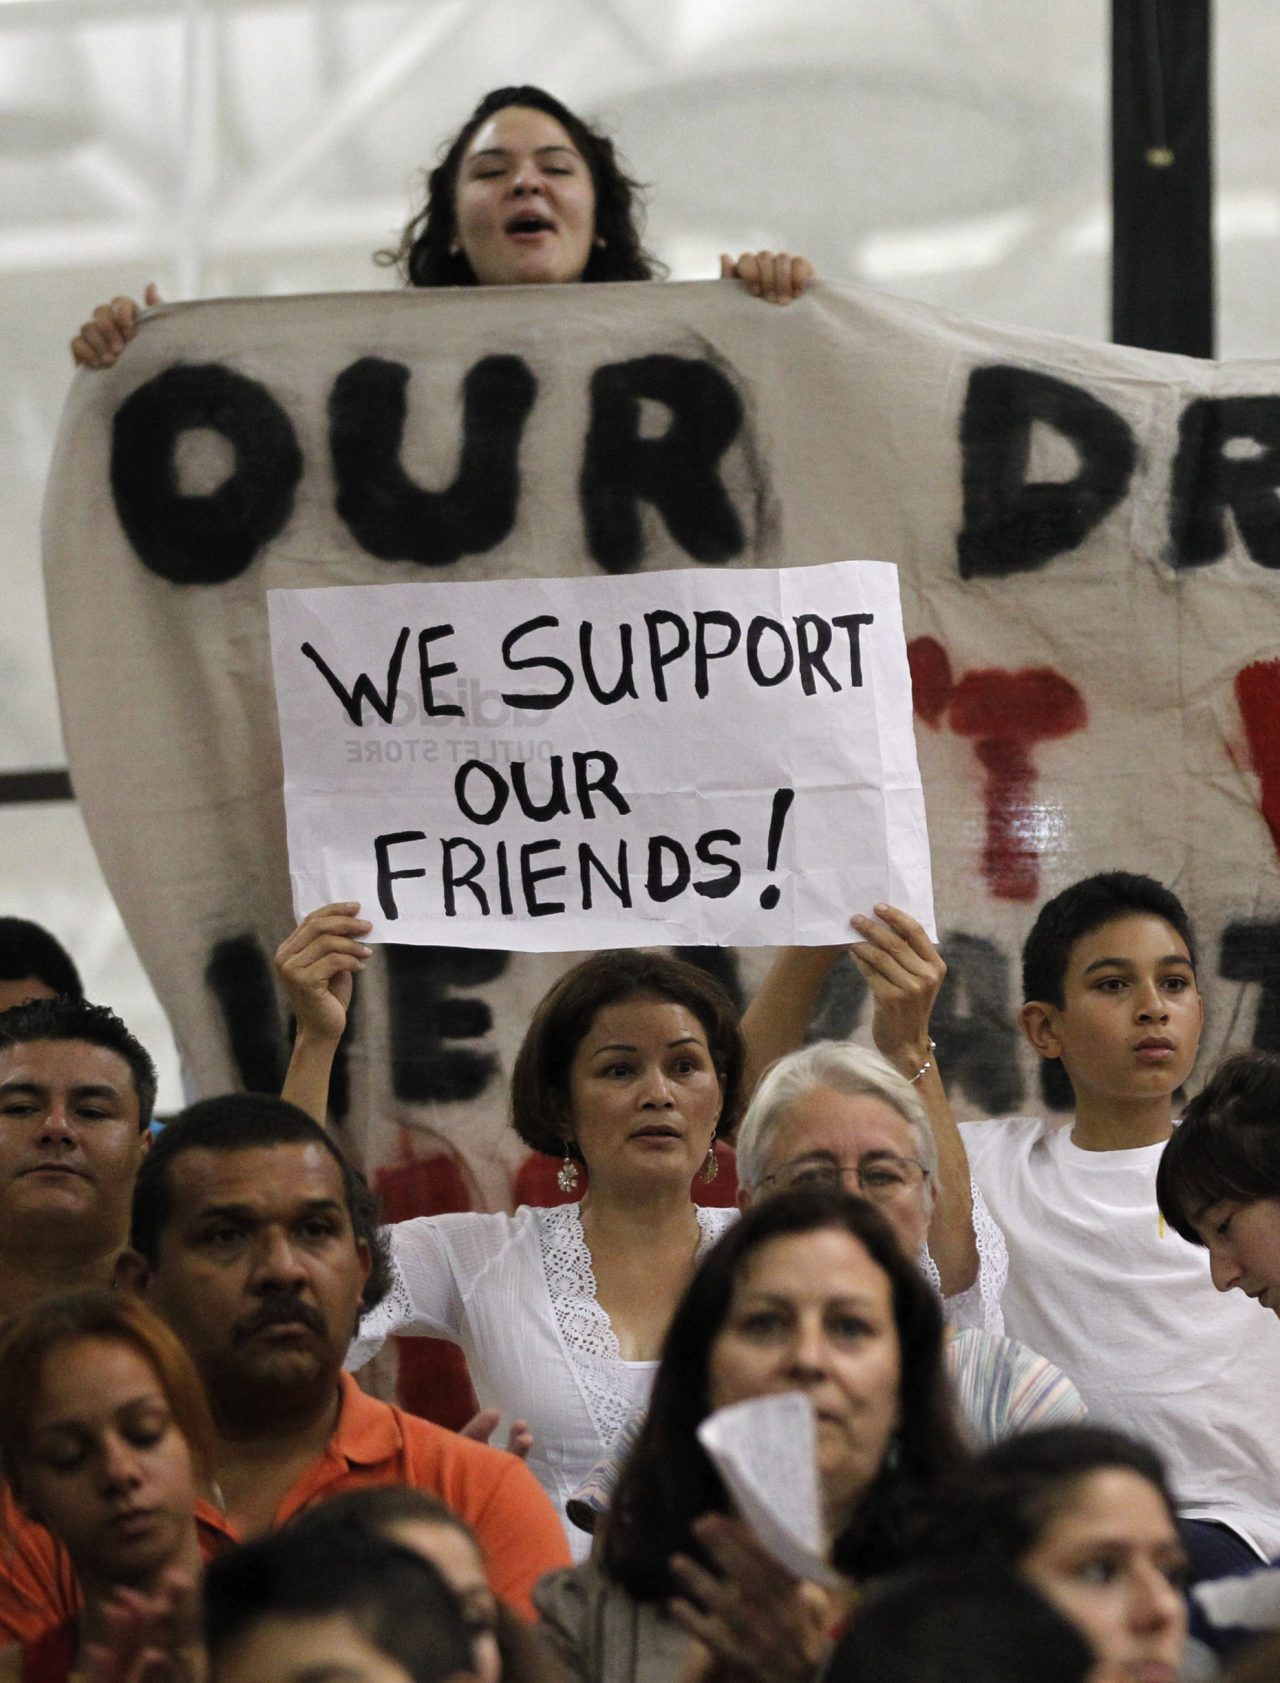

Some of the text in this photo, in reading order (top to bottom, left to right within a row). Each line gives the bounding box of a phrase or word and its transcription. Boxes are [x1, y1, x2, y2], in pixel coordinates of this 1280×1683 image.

[111, 353, 746, 585] OUR
[301, 609, 875, 727] WE SUPPORT
[454, 750, 631, 825] OUR
[373, 788, 796, 921] FRIENDS!
